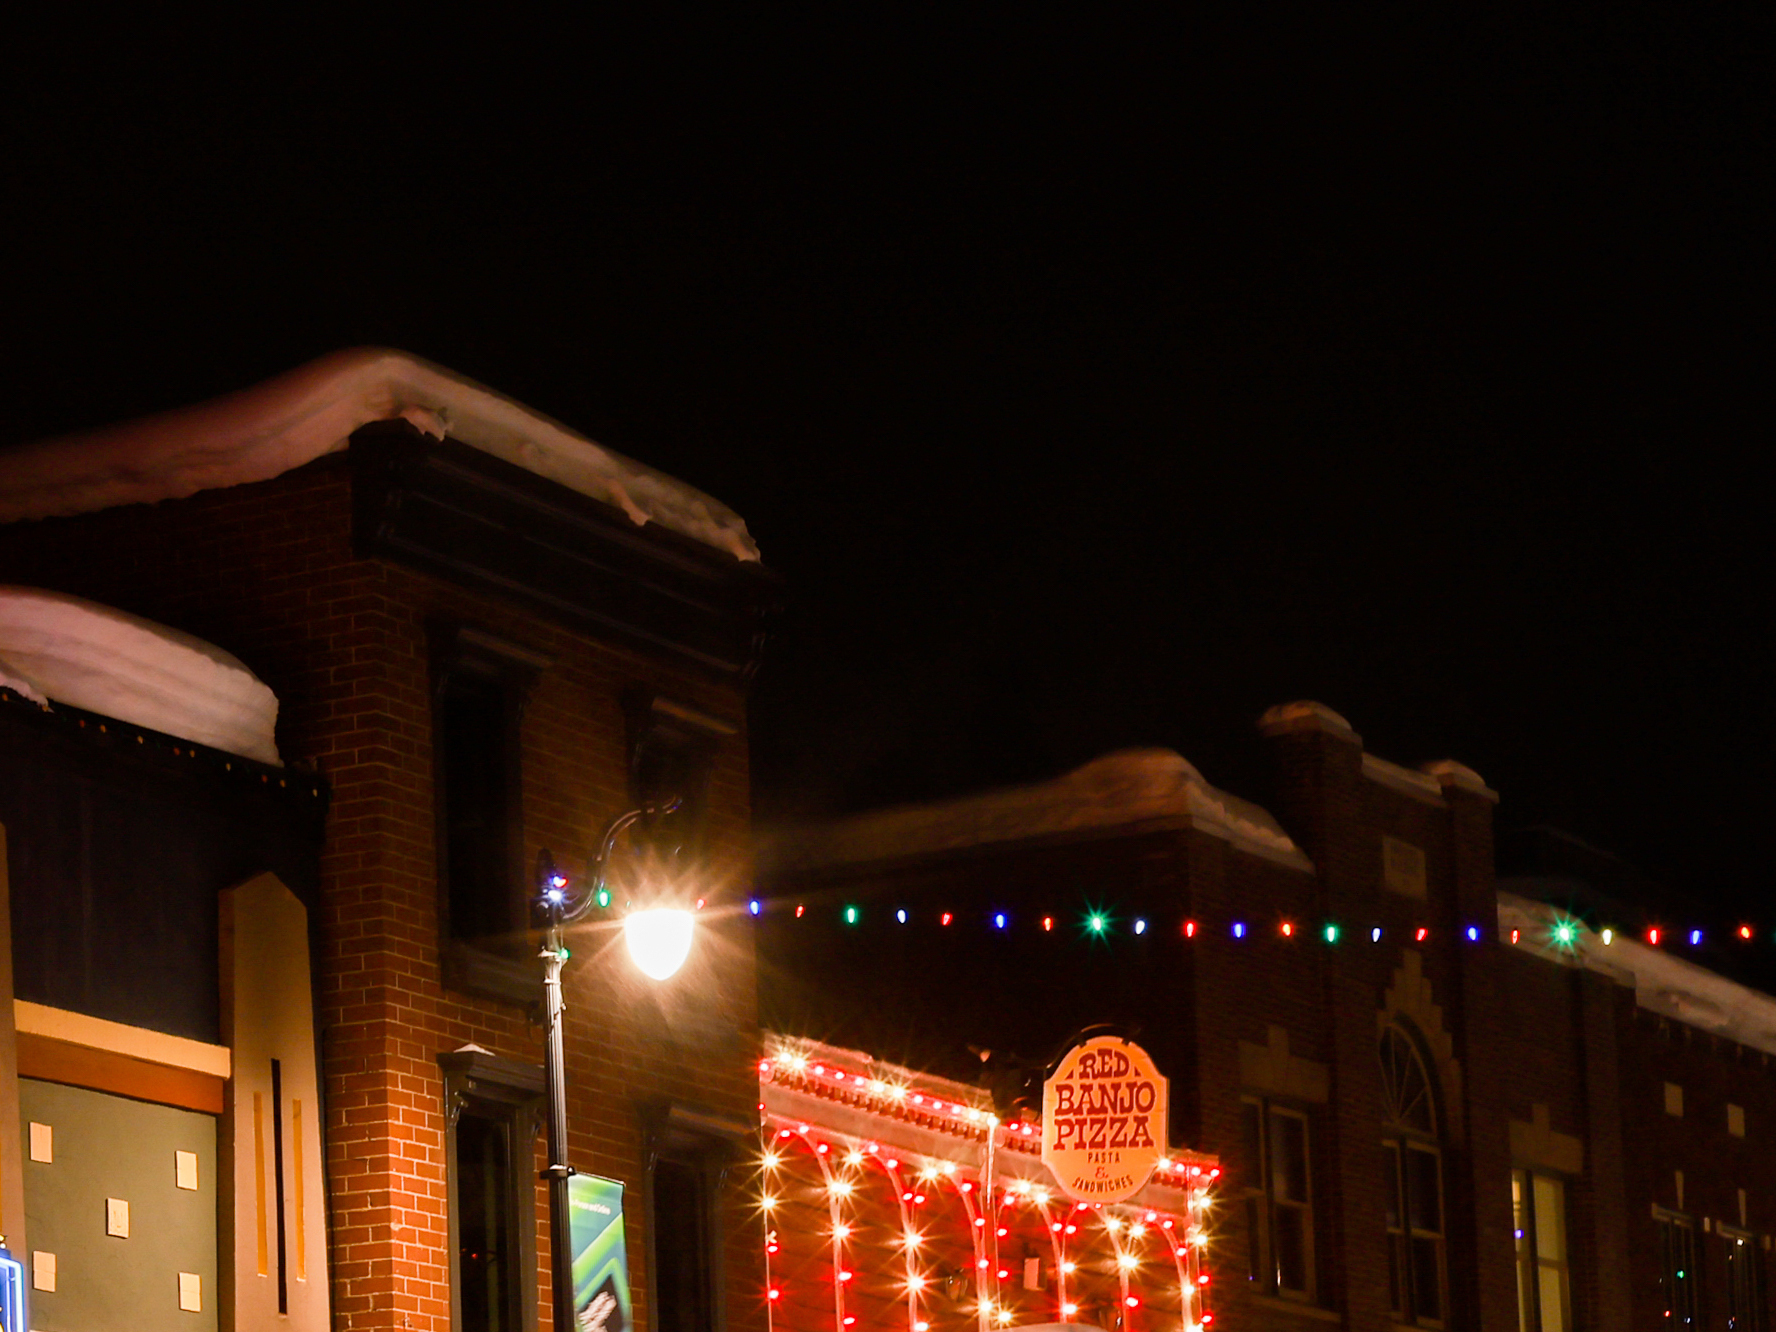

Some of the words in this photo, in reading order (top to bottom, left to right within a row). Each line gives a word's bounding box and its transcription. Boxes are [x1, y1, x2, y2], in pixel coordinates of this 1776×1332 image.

[1079, 1048, 1129, 1080] RED
[1055, 1081, 1156, 1116] BANJO
[1053, 1116, 1154, 1150] PIZZA
[1087, 1152, 1120, 1164] PASTA
[1072, 1175, 1133, 1193] SANDWICHES
[1095, 1166, 1109, 1179] &
